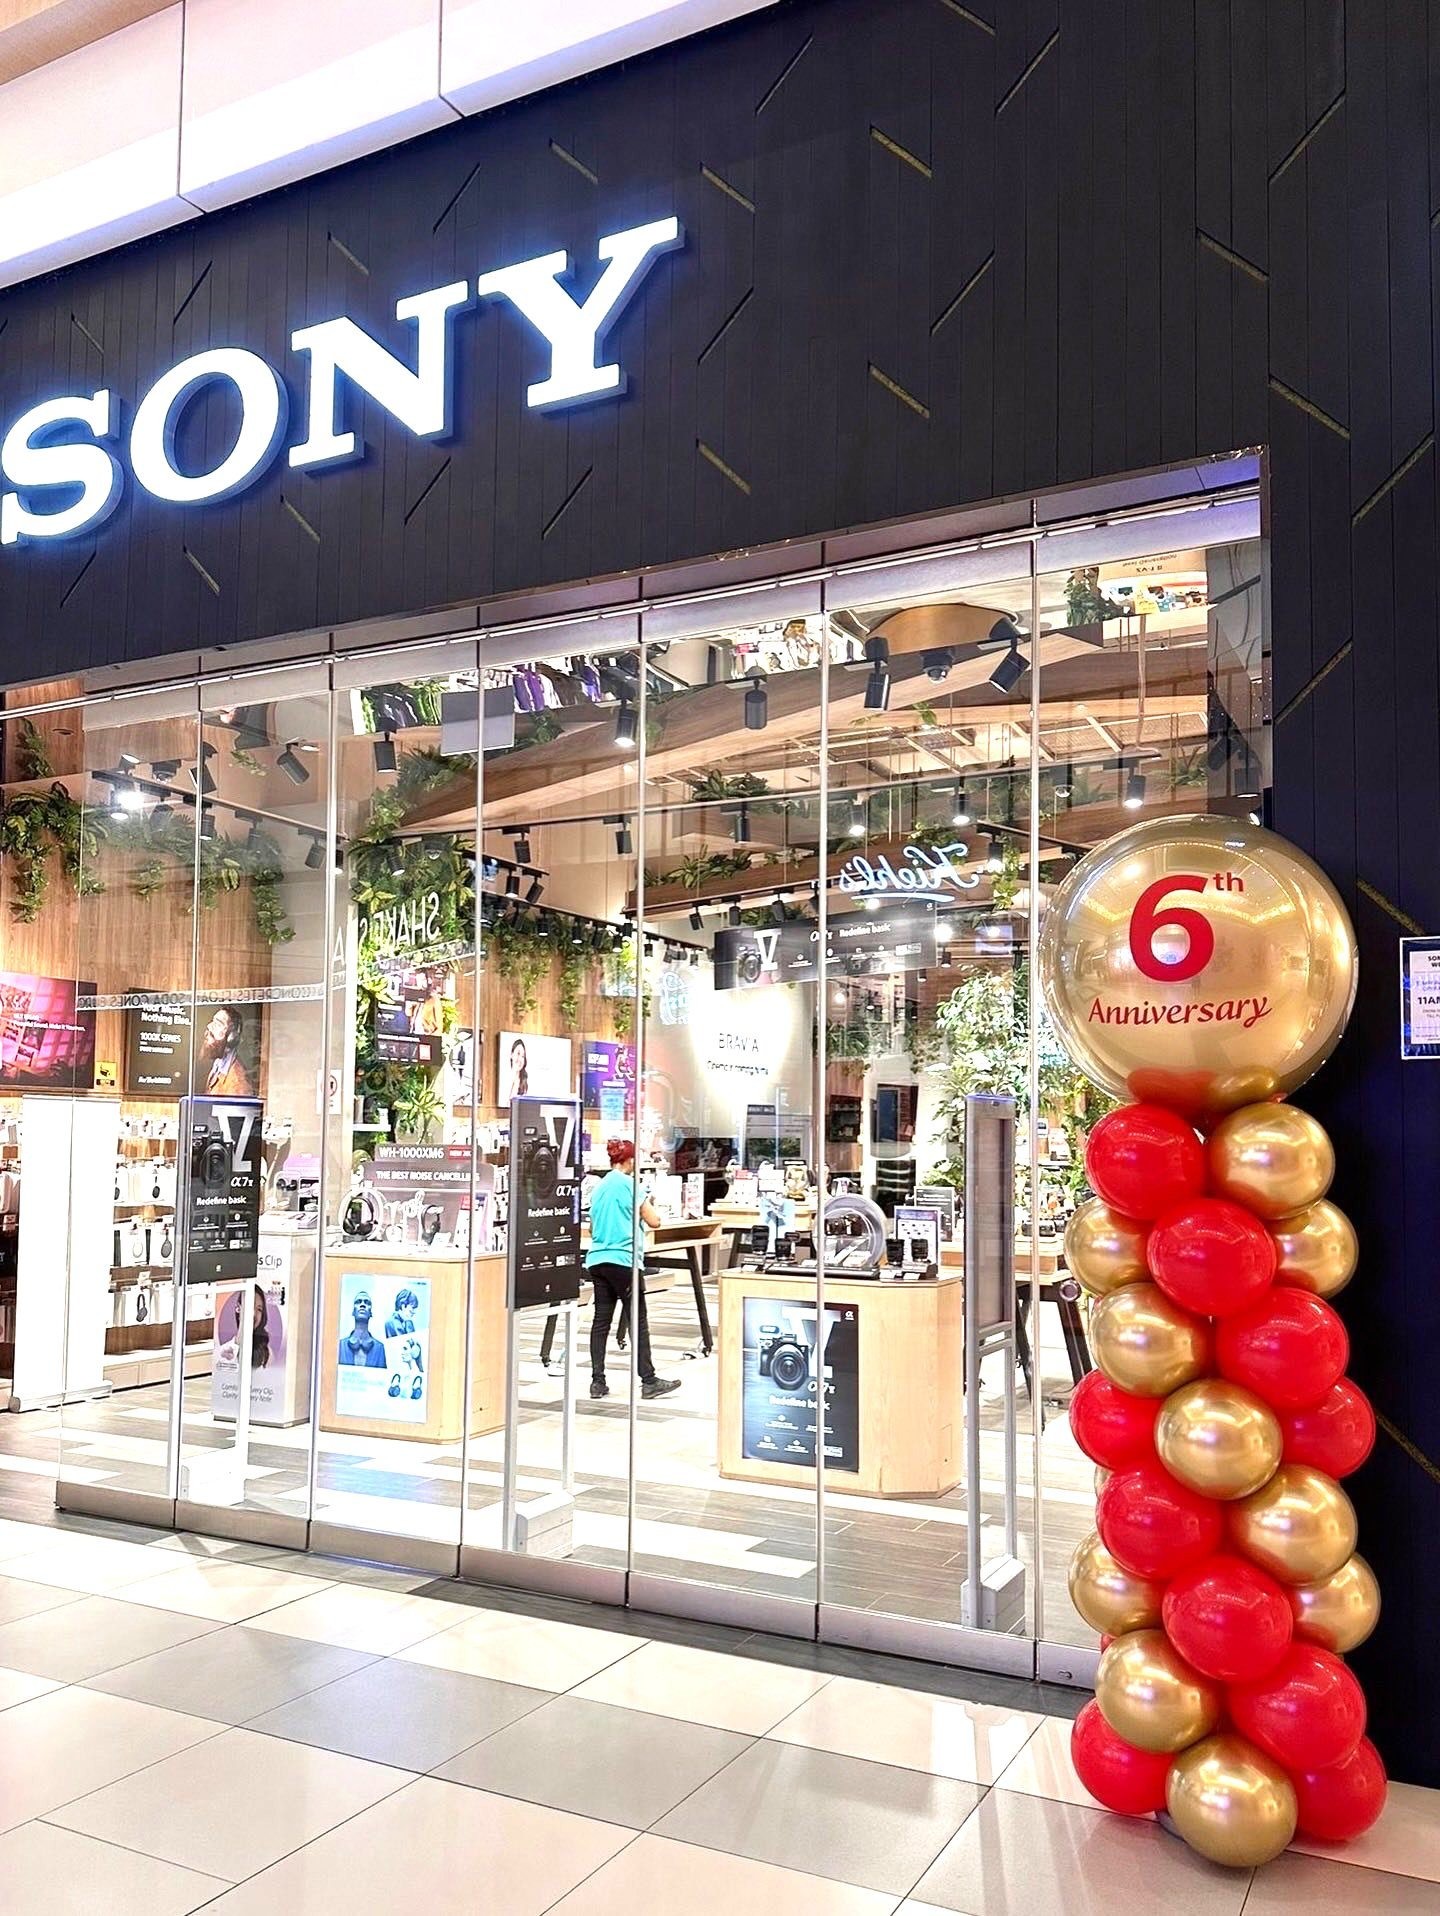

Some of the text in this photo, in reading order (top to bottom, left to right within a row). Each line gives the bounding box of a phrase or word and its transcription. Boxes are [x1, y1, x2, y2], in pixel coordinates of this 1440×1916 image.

[0, 215, 681, 547] SONY
[1129, 872, 1244, 983] 6th
[1088, 996, 1273, 1029] Anniversary
[719, 1032, 760, 1053] BRAVA
[379, 1146, 445, 1160] WH-1000XM6
[196, 1195, 247, 1206] Redefine basic
[527, 1206, 571, 1218] Redefine basic
[265, 1254, 283, 1269] Clip
